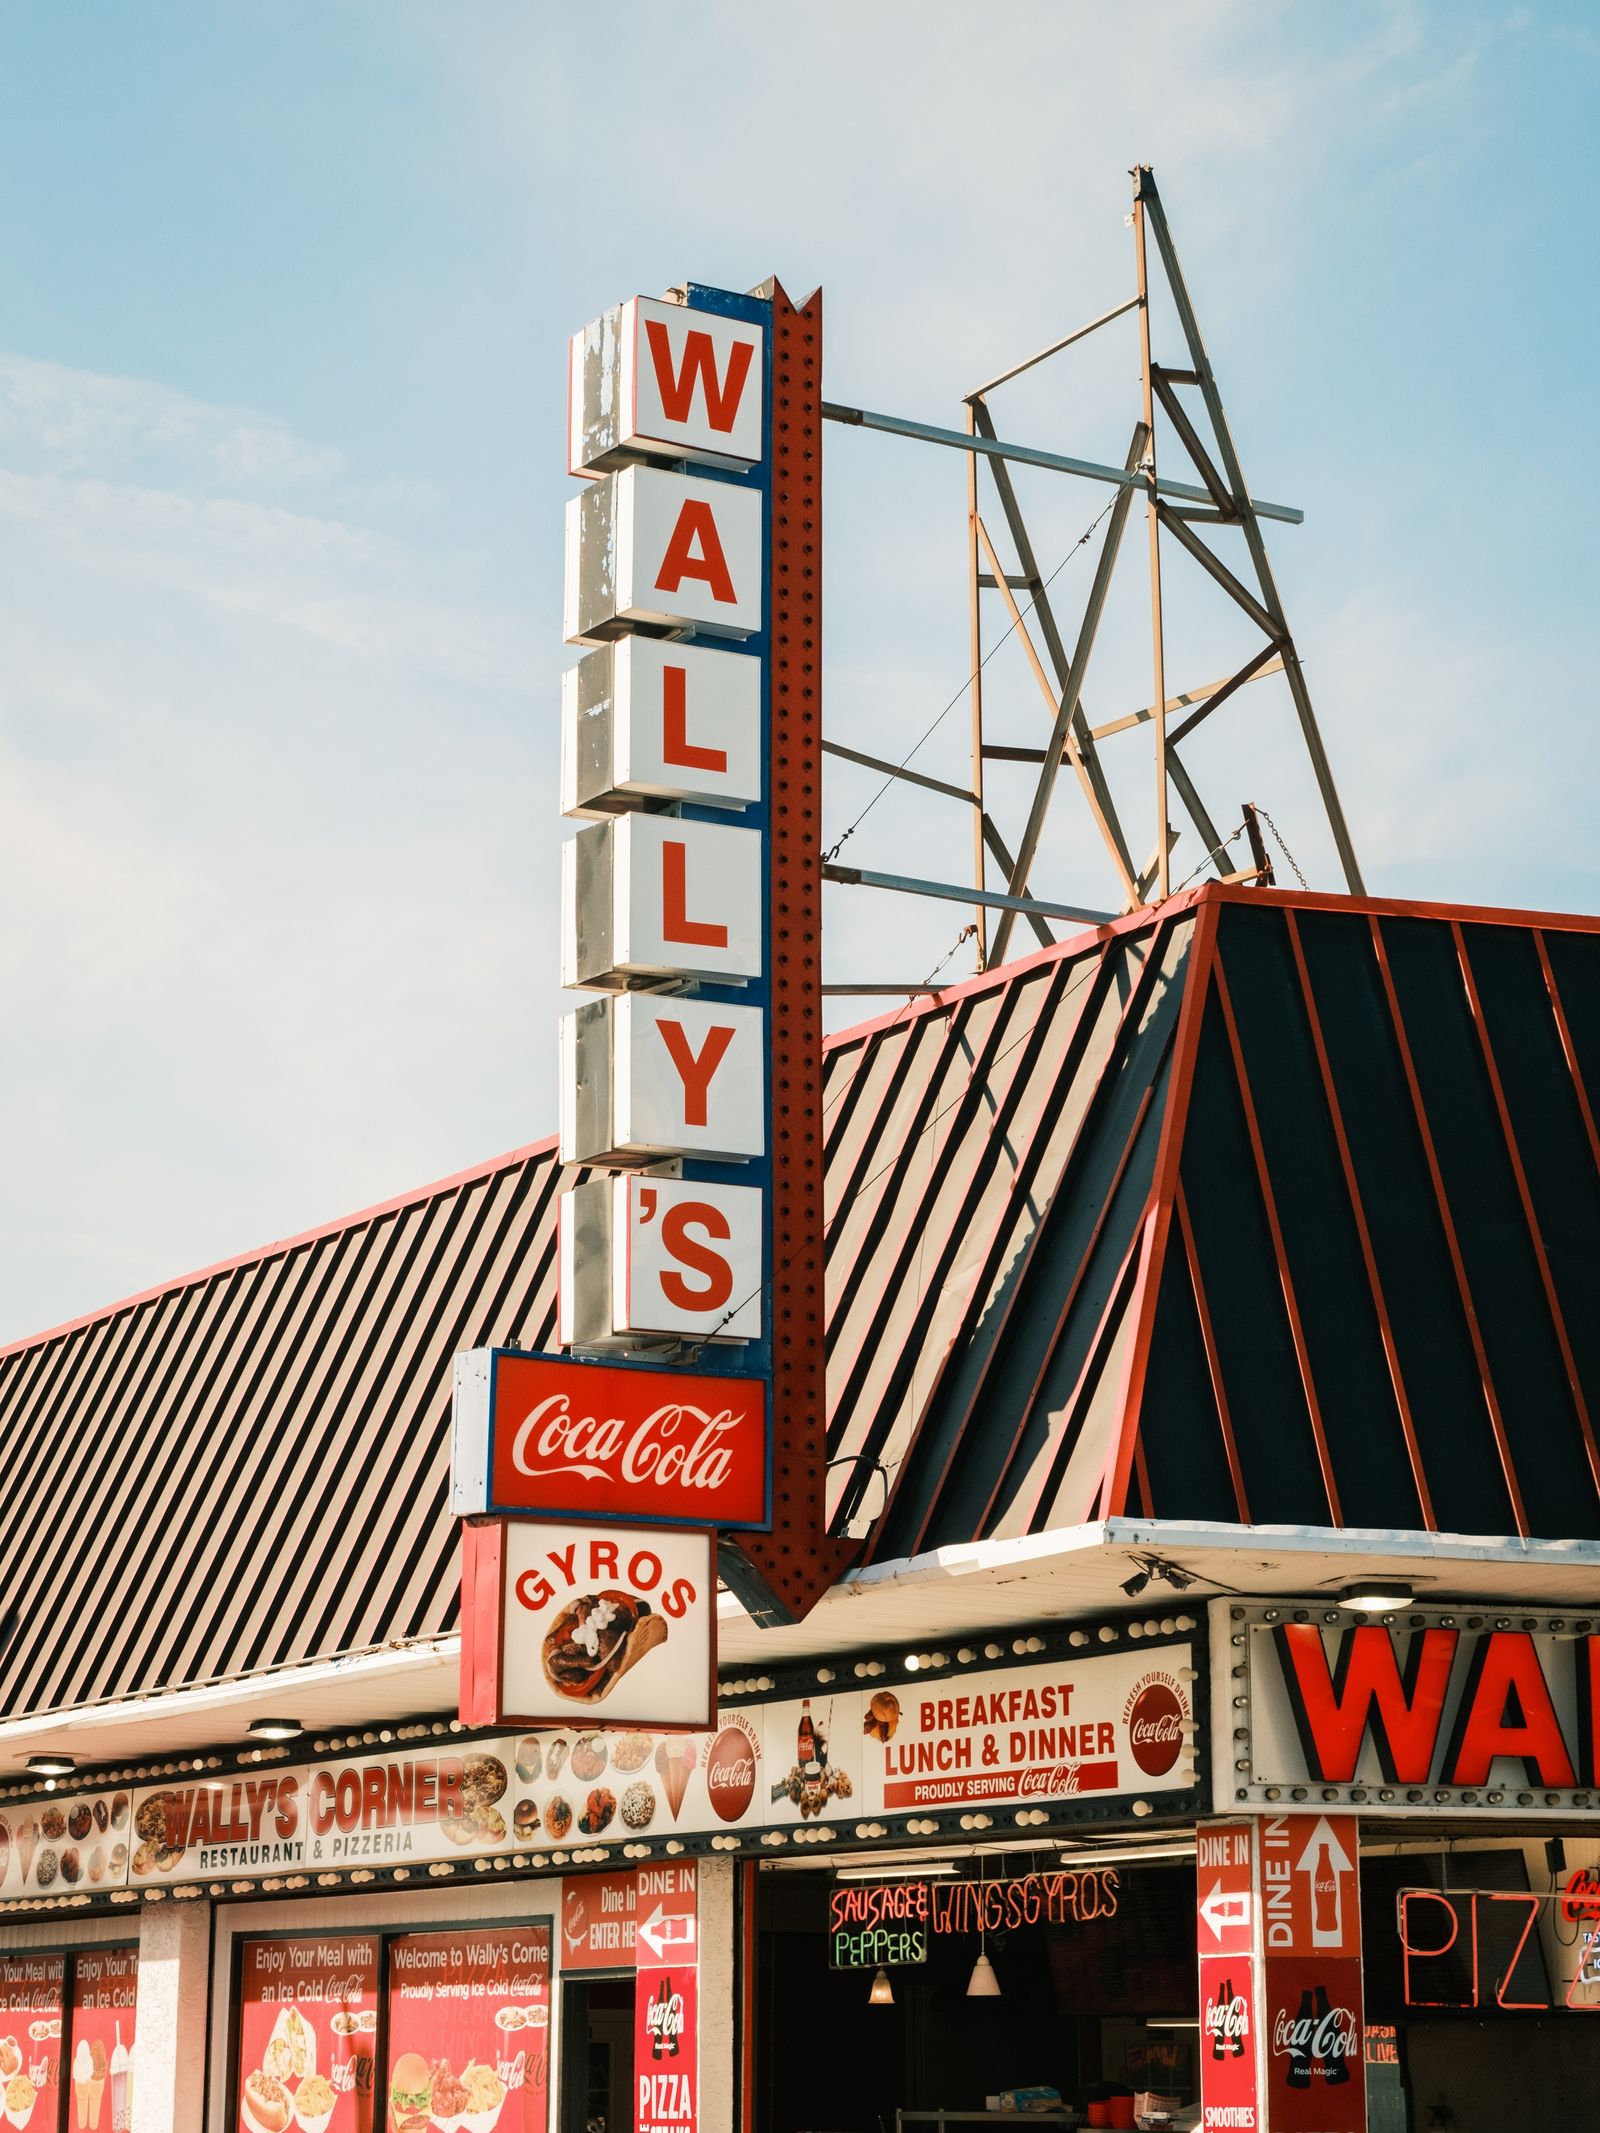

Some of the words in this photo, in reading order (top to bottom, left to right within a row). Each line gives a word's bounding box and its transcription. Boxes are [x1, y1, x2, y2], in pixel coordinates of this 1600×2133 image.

[640, 319, 755, 1312] WALLY'S
[515, 1541, 696, 1619] GYROS
[920, 1684, 1074, 1732] BREAKFAST
[1122, 1682, 1142, 1725] REFRESH
[1141, 1671, 1175, 1687] YOURSELF
[1174, 1684, 1190, 1717] DRINK
[701, 1731, 717, 1768] REFRES
[719, 1713, 749, 1730] YOURSELF
[748, 1728, 762, 1761] DRINK
[1132, 1714, 1182, 1745] Coca-Cola
[885, 1737, 972, 1776] LUNCH
[981, 1734, 1000, 1766] &
[1010, 1722, 1115, 1763] DINNER
[709, 1758, 754, 1789] Coca-Cola
[915, 1782, 964, 1800] PROUDLY
[967, 1777, 1015, 1796] SERVING
[1017, 1762, 1082, 1799] Coca-Cola
[165, 1776, 298, 1849] WALLY'S
[309, 1757, 465, 1836] CORNER
[1264, 1814, 1290, 1847] IN
[200, 1842, 304, 1869] RESTAURANT
[313, 1841, 323, 1859] &
[333, 1832, 413, 1858] PIZZERIA
[1200, 1836, 1231, 1867] DINE
[1234, 1834, 1249, 1866] IN
[601, 1886, 624, 1913] Dine
[626, 1884, 636, 1911] In
[639, 1869, 675, 1896] DINE
[679, 1868, 695, 1893] IN
[1023, 1870, 1120, 1924] GYROS
[831, 1884, 918, 1933] SAUSAGE
[932, 1882, 1022, 1933] WINGS
[1265, 1860, 1293, 1947] DINE
[590, 1922, 620, 1950] ENTER
[622, 1920, 637, 1948] HE
[835, 1929, 924, 1966] PEPPERS
[4, 1963, 23, 1982] Your
[25, 1962, 45, 1981] Meal
[76, 1958, 102, 1981] Enjoy
[105, 1957, 128, 1976] Your
[256, 1947, 286, 1973] Enjoy
[289, 1946, 315, 1967] Your
[317, 1944, 344, 1967] Meal
[347, 1942, 372, 1965] with
[394, 1947, 447, 1969] Welcome
[450, 1947, 463, 1966] to
[466, 1943, 508, 1968] Wally's
[511, 1942, 548, 1963] Corne
[10, 1992, 29, 2012] Cold
[83, 1994, 94, 2010] an
[97, 1989, 111, 2008] Ice
[112, 1986, 136, 2007] Cold
[262, 1985, 275, 2003] an
[278, 1981, 294, 2002] Ice
[297, 1979, 323, 2002] Cold
[400, 1983, 434, 2001] Proudly
[436, 1981, 469, 2000] Serving
[472, 1980, 485, 1997] Ice
[487, 1978, 508, 1996] Cold
[1294, 2067, 1312, 2075] Real
[1314, 2067, 1337, 2077] Magic
[639, 2074, 692, 2120] PIZZA
[1205, 2106, 1255, 2128] SMOOTHIES
